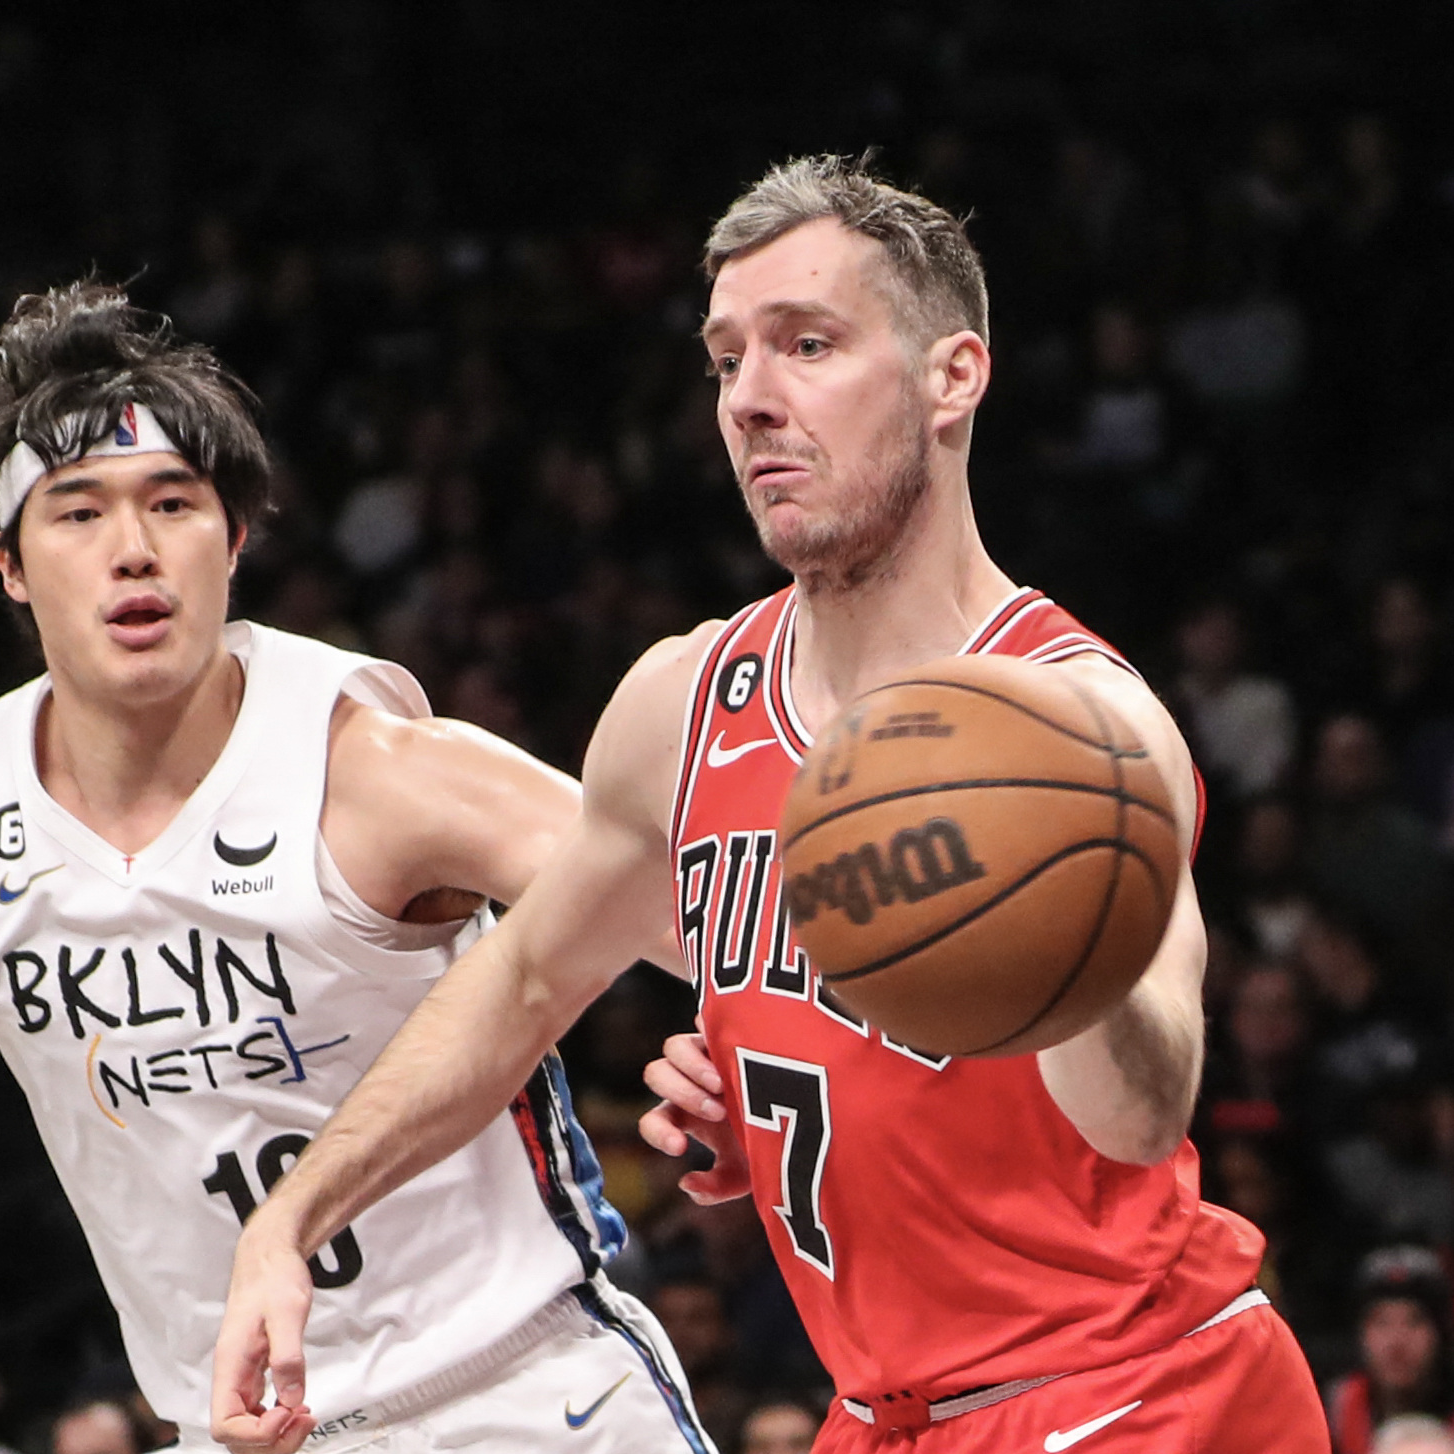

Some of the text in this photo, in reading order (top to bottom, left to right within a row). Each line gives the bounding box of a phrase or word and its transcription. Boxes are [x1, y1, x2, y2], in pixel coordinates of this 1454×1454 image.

[726, 660, 756, 707] 6
[211, 876, 274, 896] Webull
[785, 816, 987, 928] Wilso
[2, 928, 297, 1040] BKLYN
[676, 829, 952, 1072] BUL
[735, 1046, 834, 1282] 7
[309, 1408, 368, 1440] NETS
